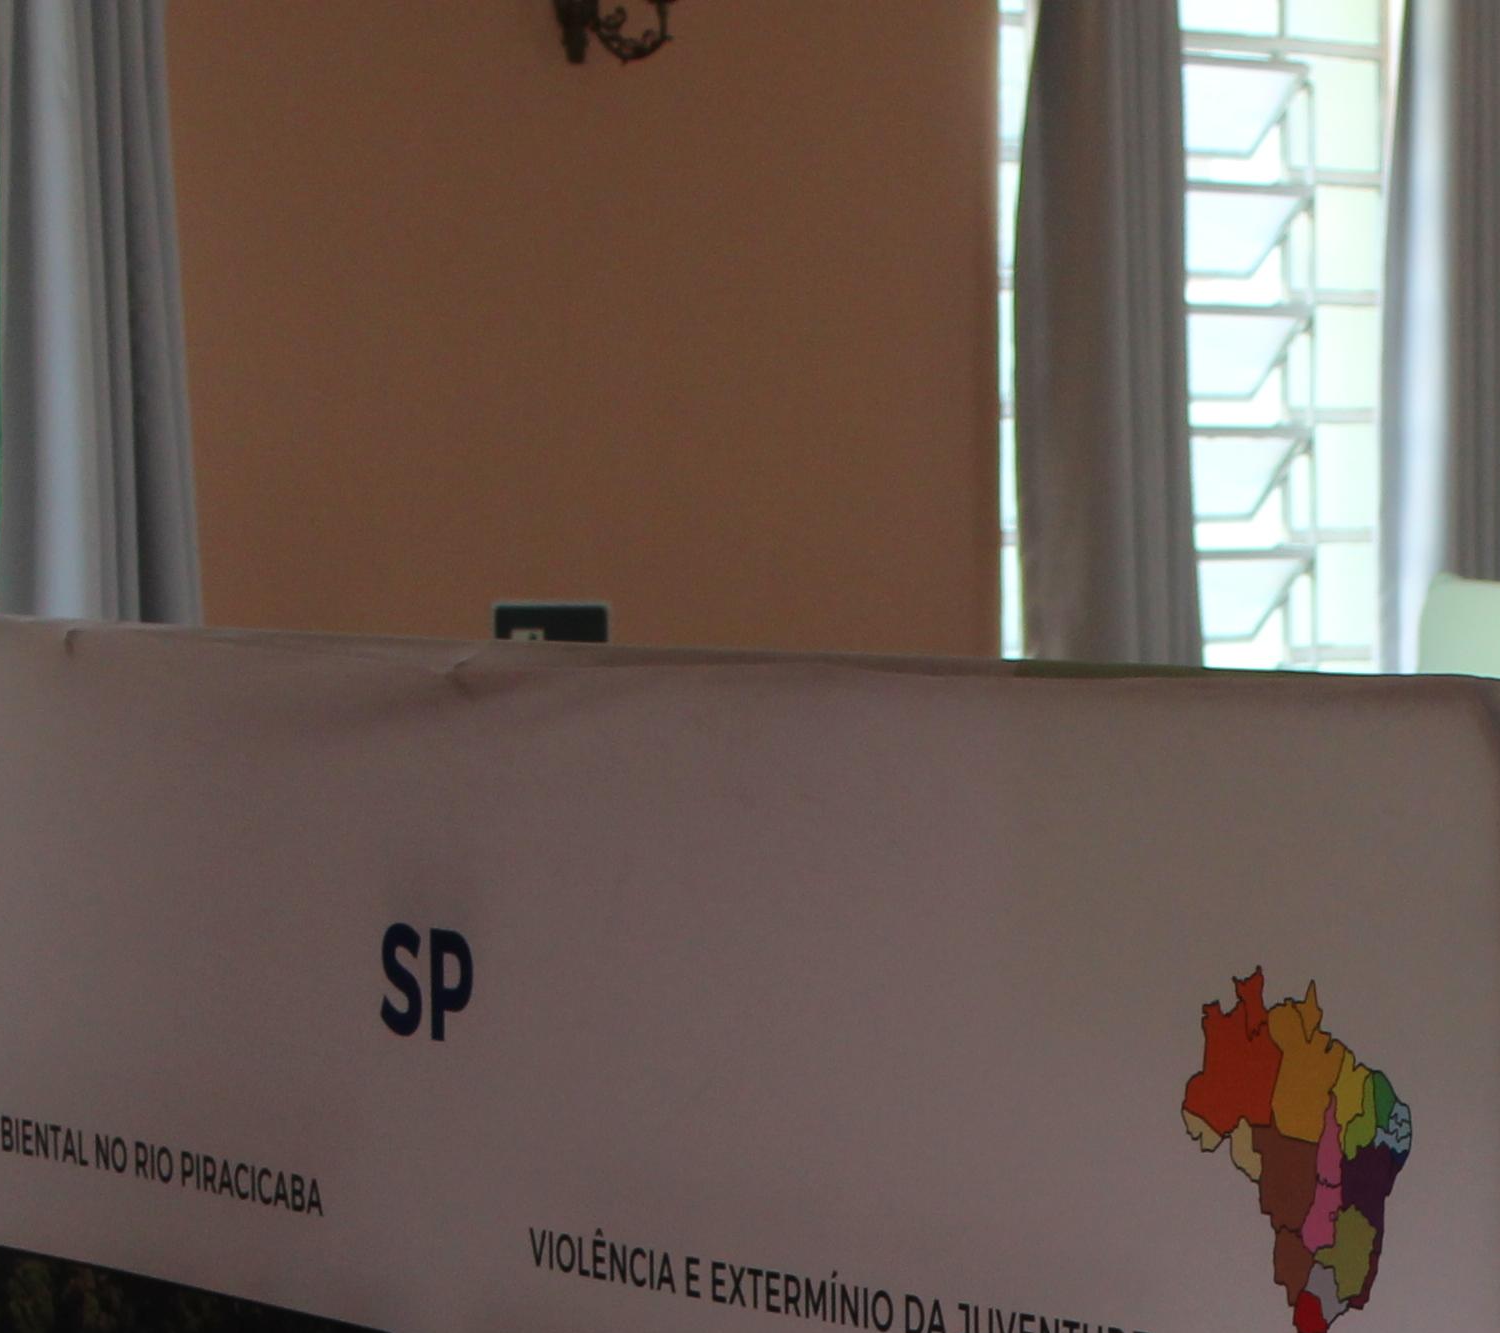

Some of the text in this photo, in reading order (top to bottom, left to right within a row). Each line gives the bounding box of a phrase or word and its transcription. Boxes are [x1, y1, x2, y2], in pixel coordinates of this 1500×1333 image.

[380, 922, 473, 1041] SP
[95, 1133, 128, 1174] NO
[134, 1141, 174, 1185] RIO
[180, 1150, 324, 1217] PIRACICABA
[529, 1226, 676, 1295] VIOLÊNCIA
[685, 1255, 701, 1299] E
[710, 1260, 894, 1333] EXTERMÍNIO
